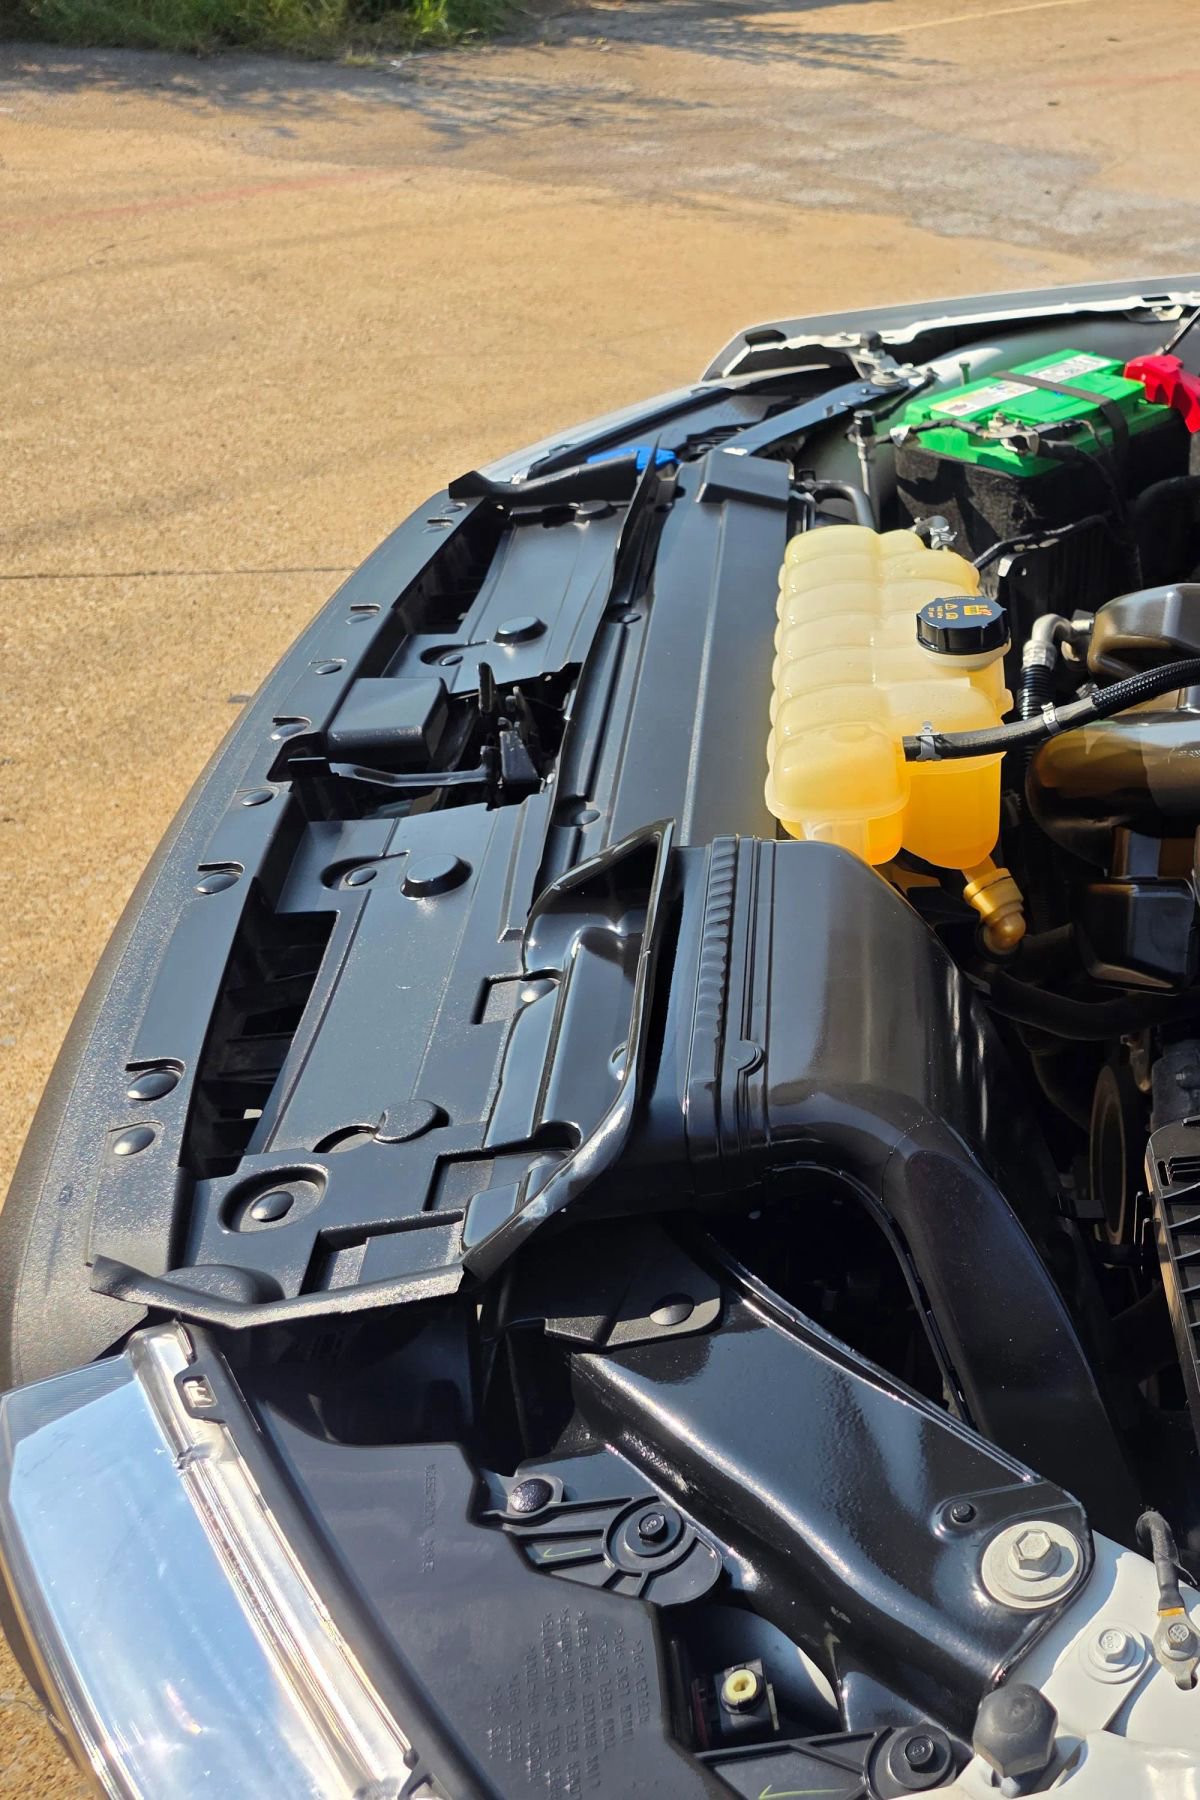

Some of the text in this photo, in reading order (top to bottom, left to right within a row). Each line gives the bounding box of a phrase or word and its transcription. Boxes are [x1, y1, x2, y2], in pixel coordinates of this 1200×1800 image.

[600, 1679, 613, 1710] REFL
[615, 1666, 631, 1695] LENS
[582, 1692, 598, 1748] BRACKET
